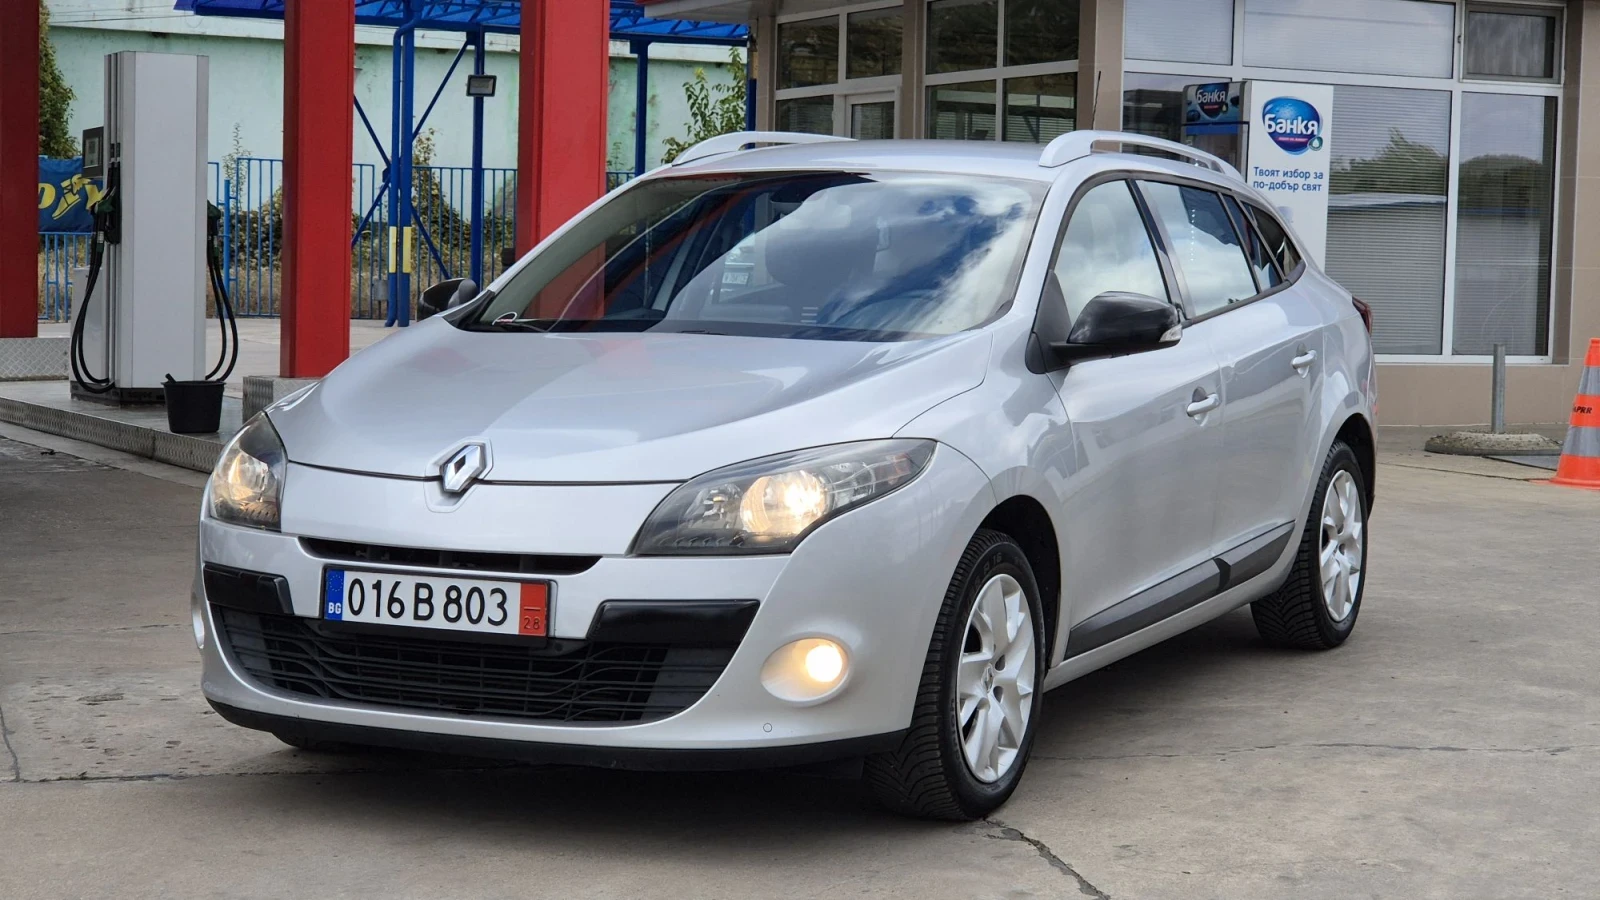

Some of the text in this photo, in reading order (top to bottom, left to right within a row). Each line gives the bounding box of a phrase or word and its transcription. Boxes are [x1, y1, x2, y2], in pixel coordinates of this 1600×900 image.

[1264, 113, 1318, 135] банкя
[1253, 166, 1324, 180] Твоят избор за
[1253, 180, 1322, 192] по-добър свят
[328, 601, 342, 615] BG
[523, 616, 540, 630] 28
